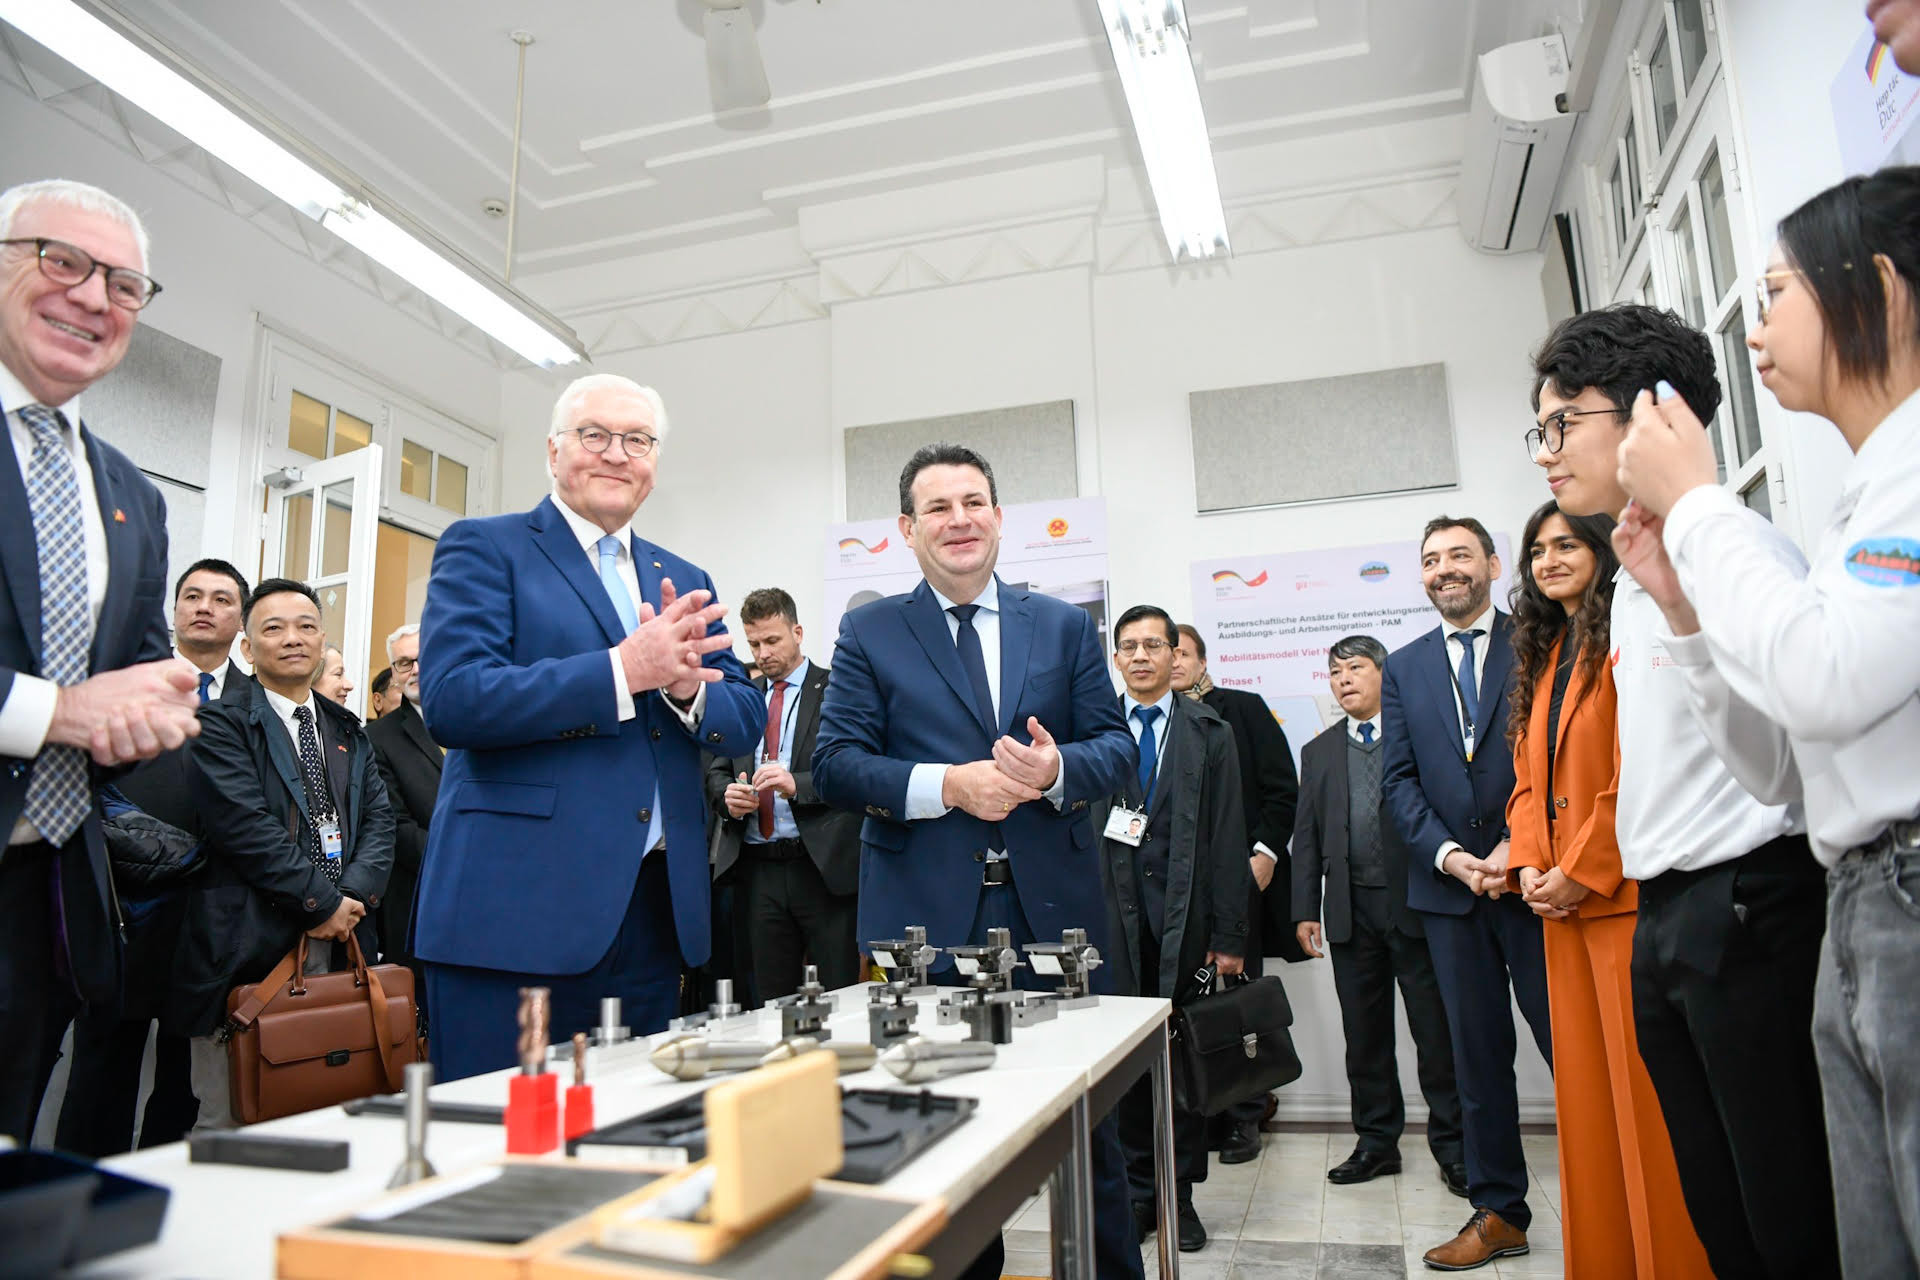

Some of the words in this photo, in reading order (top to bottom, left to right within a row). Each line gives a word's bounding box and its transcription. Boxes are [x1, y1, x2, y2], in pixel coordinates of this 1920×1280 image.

[1217, 616, 1298, 629] Partnerschaftliche
[1299, 613, 1335, 623] Ansätze
[1337, 610, 1350, 620] für
[1352, 605, 1438, 618] entwicklungsorien
[1218, 628, 1277, 640] Ausbildungs-
[1279, 626, 1296, 635] und
[1298, 621, 1373, 634] Arbeitsmigration
[1381, 618, 1402, 627] PAM
[1220, 649, 1299, 663] Mobilitätsmodell
[1301, 648, 1320, 657] Viet
[1221, 677, 1253, 687] Phase
[1256, 675, 1262, 685] 1
[1312, 671, 1331, 680] Pha
